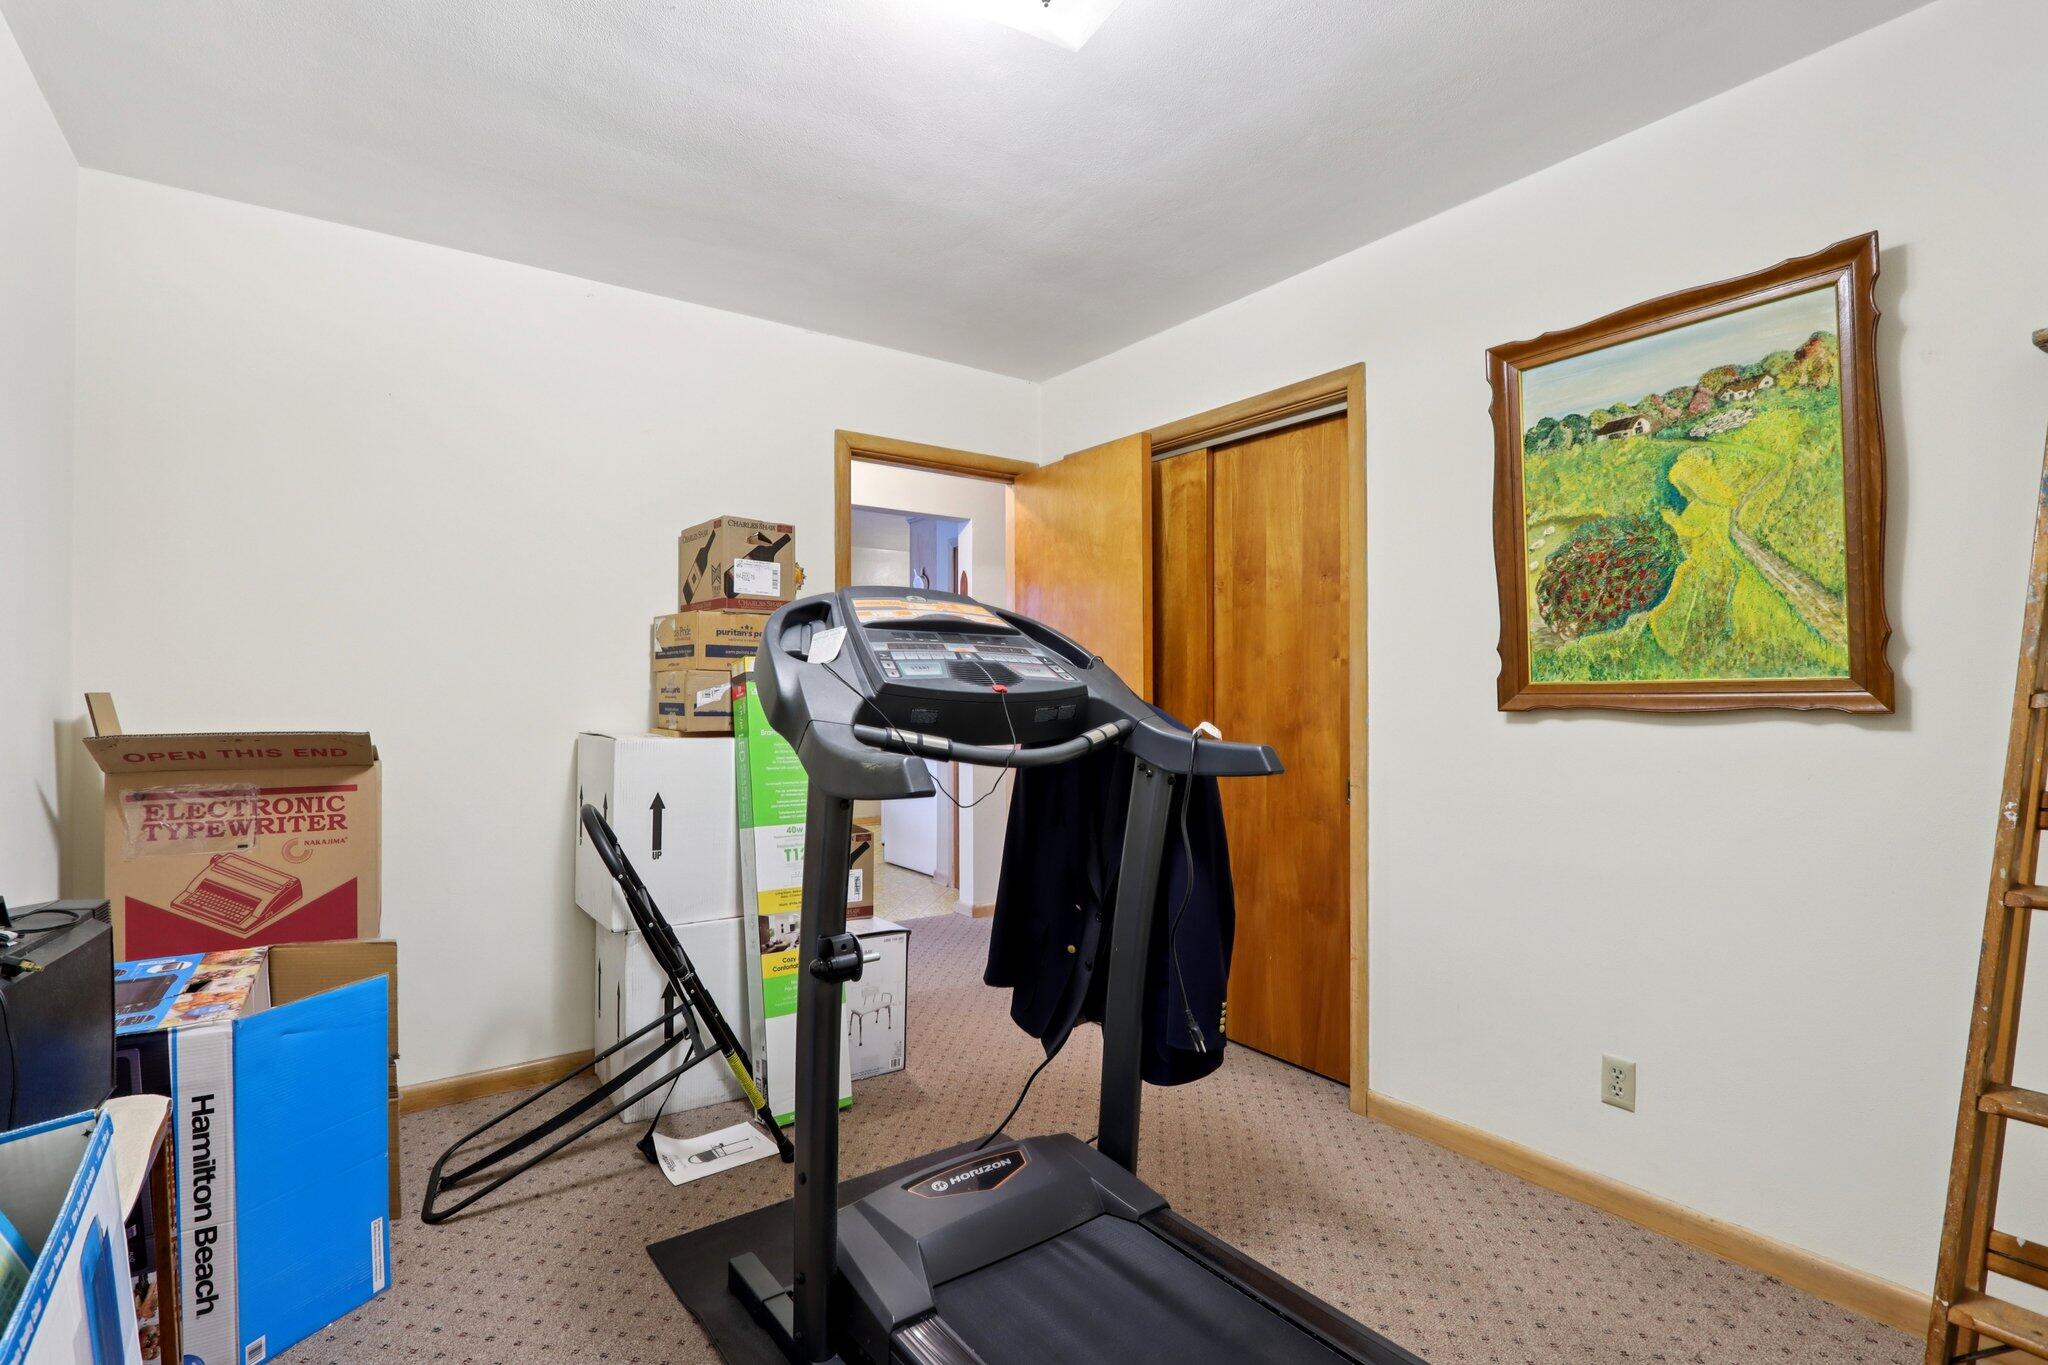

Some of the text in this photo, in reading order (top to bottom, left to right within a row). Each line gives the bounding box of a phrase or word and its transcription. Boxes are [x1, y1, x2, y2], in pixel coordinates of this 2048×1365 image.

[715, 628, 753, 637] puritan's
[123, 747, 348, 763] OPEN THIS END
[143, 795, 346, 823] ELECTRONIC
[141, 813, 348, 842] TYPEWRITER
[304, 837, 346, 847] NAKAJIMA
[652, 851, 662, 860] UP
[949, 1158, 1012, 1185] HORIZON
[191, 1093, 219, 1317] Hamilton Beach
